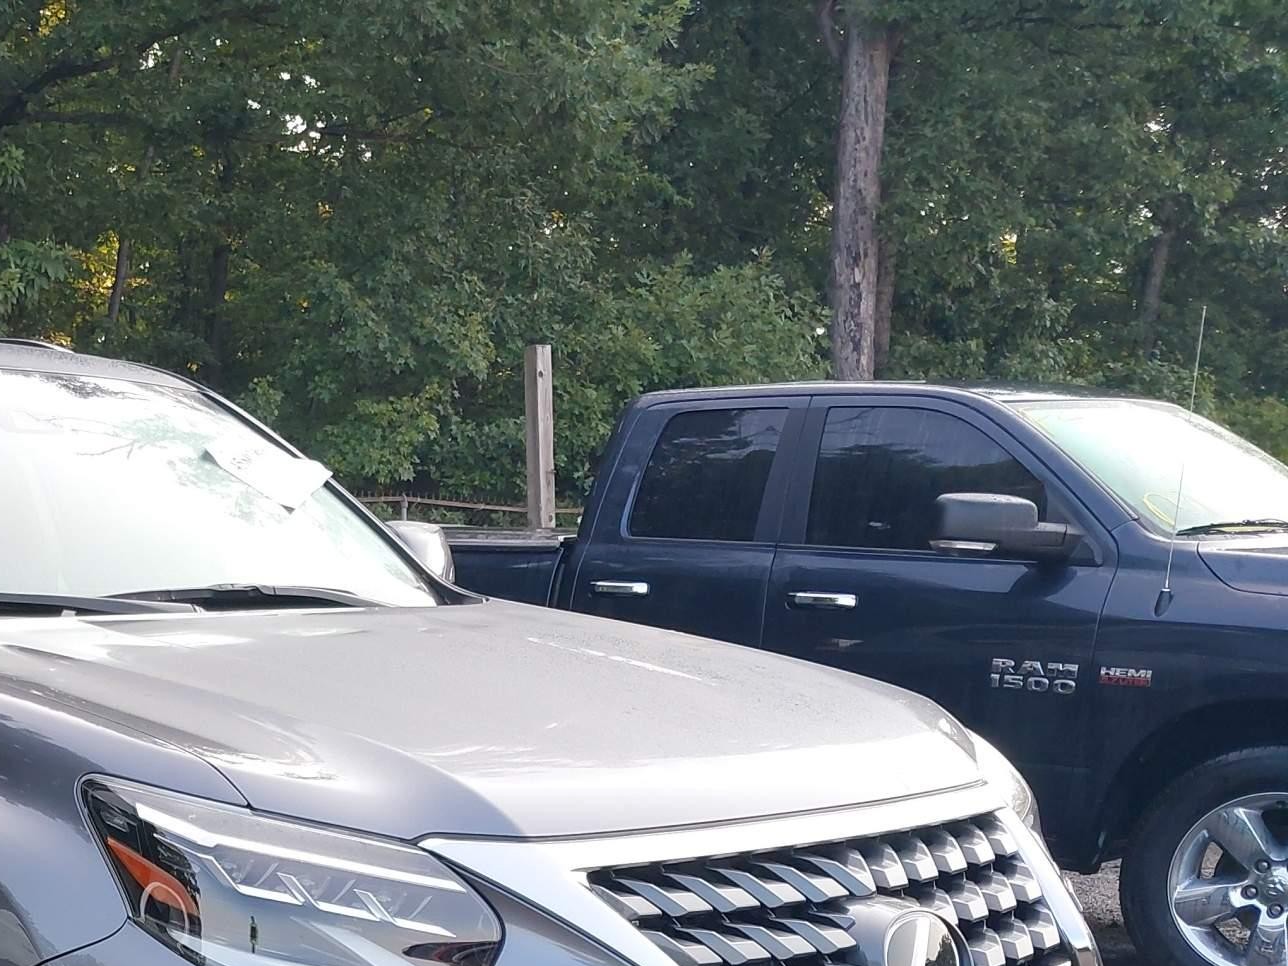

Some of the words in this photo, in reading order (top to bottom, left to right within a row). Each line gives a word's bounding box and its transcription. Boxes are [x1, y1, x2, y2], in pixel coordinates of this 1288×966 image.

[990, 657, 1080, 678] RAM
[1099, 666, 1153, 679] HEMI
[989, 674, 1077, 695] 1500
